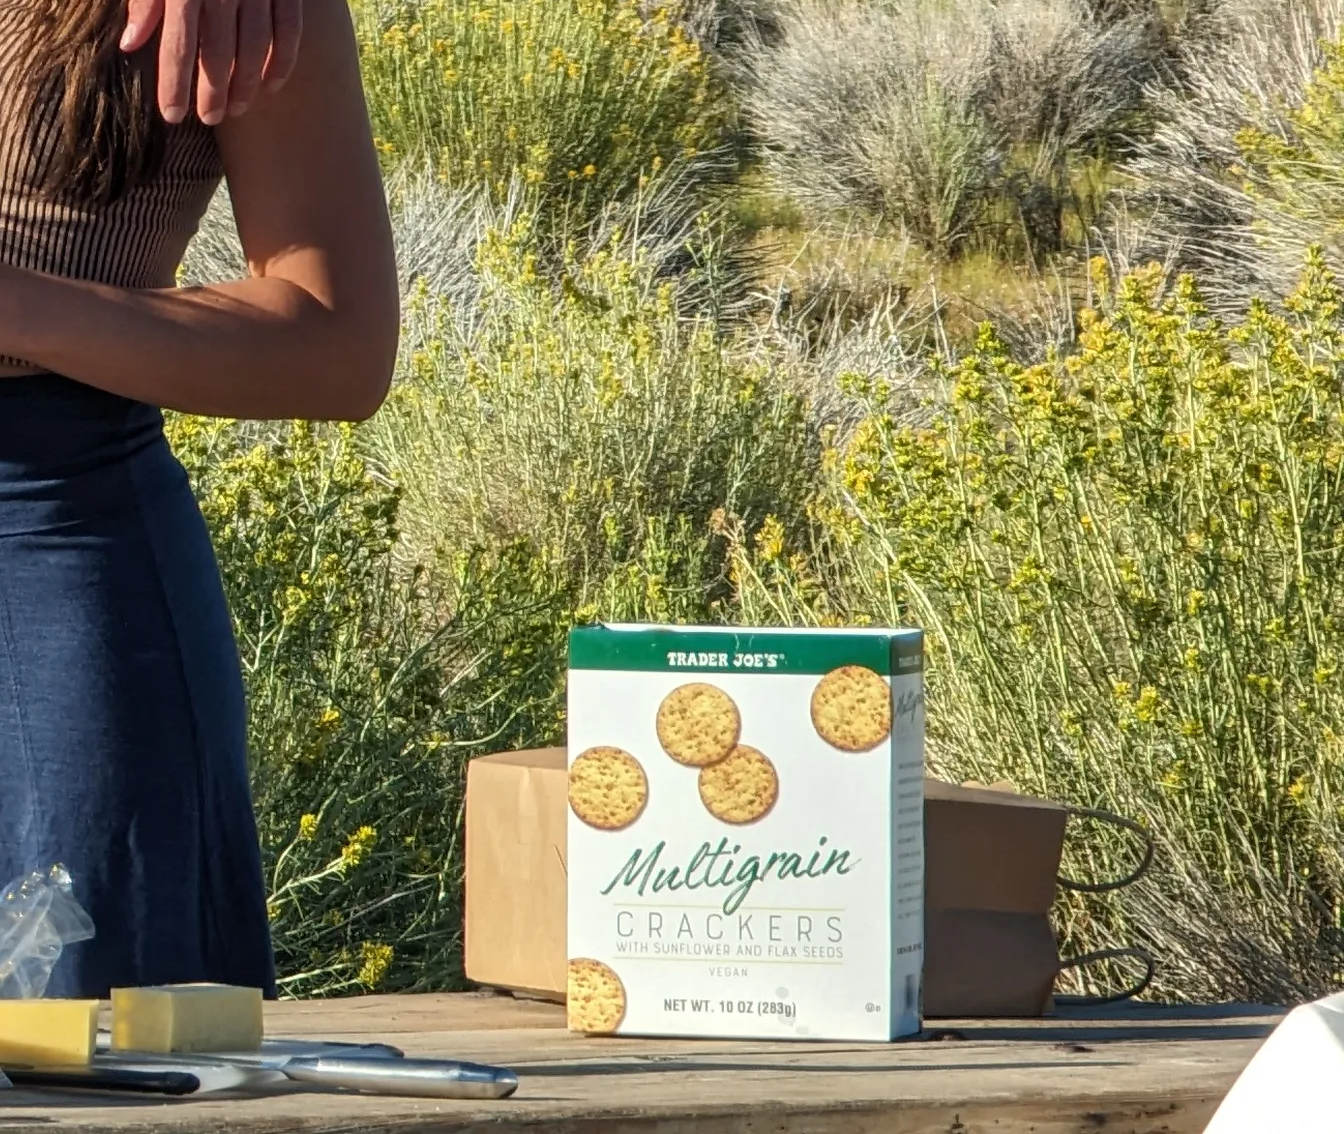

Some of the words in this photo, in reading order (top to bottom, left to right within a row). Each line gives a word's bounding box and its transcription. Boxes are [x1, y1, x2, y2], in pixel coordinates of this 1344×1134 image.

[667, 652, 728, 667] TRADER
[733, 653, 779, 668] JOE'S
[600, 836, 862, 916] Multigrain
[617, 911, 843, 943] CRACKERS
[616, 941, 649, 953] WITH
[654, 942, 730, 956] SUNFLOWER
[736, 945, 762, 957] AND
[768, 945, 797, 958] FLAX
[803, 946, 843, 959] SEEDS
[708, 966, 748, 978] VEGAN
[664, 998, 687, 1012] NET
[691, 999, 714, 1013] WT.
[719, 1000, 734, 1014] 10
[737, 1001, 754, 1014] OZ
[758, 1001, 797, 1018] (283g)
